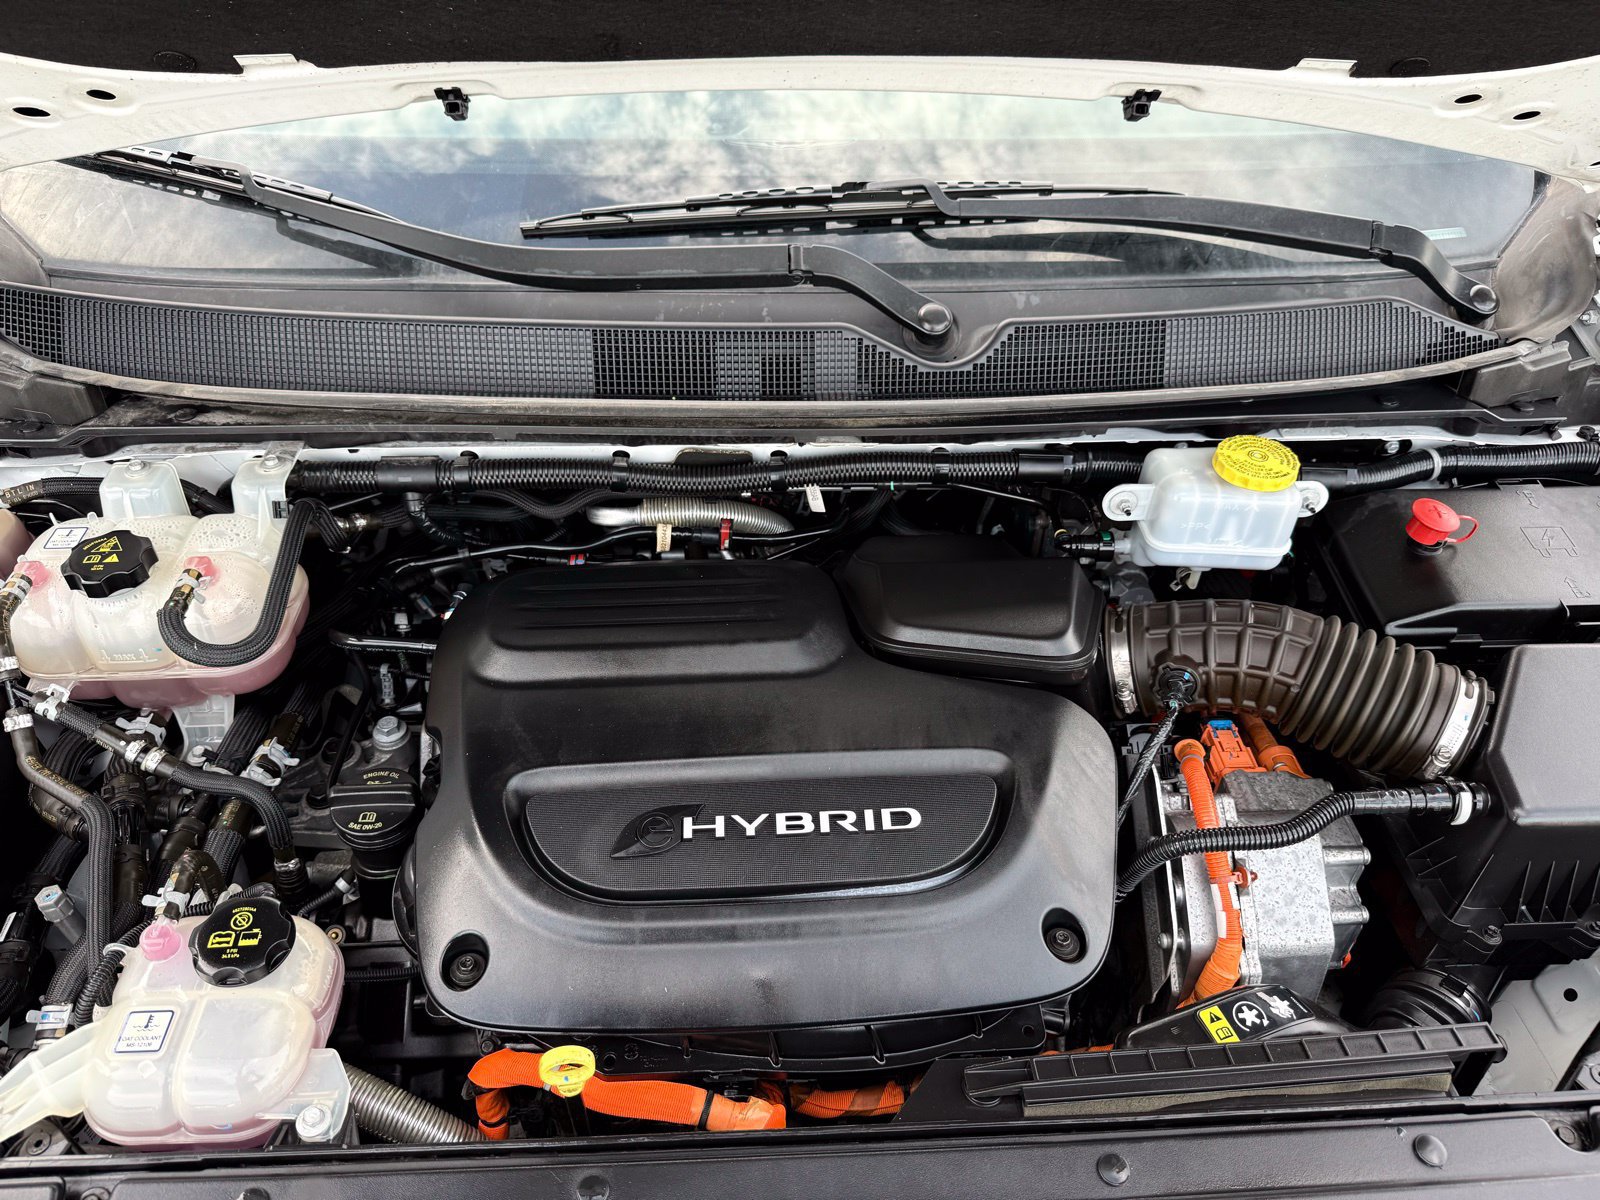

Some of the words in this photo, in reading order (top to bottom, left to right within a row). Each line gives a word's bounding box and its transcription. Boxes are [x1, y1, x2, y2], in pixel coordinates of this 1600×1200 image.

[363, 770, 389, 780] ENGINE
[389, 771, 400, 779] OIL
[348, 822, 361, 830] SAE
[361, 822, 383, 830] 0W-20
[683, 806, 923, 839] HYBRID
